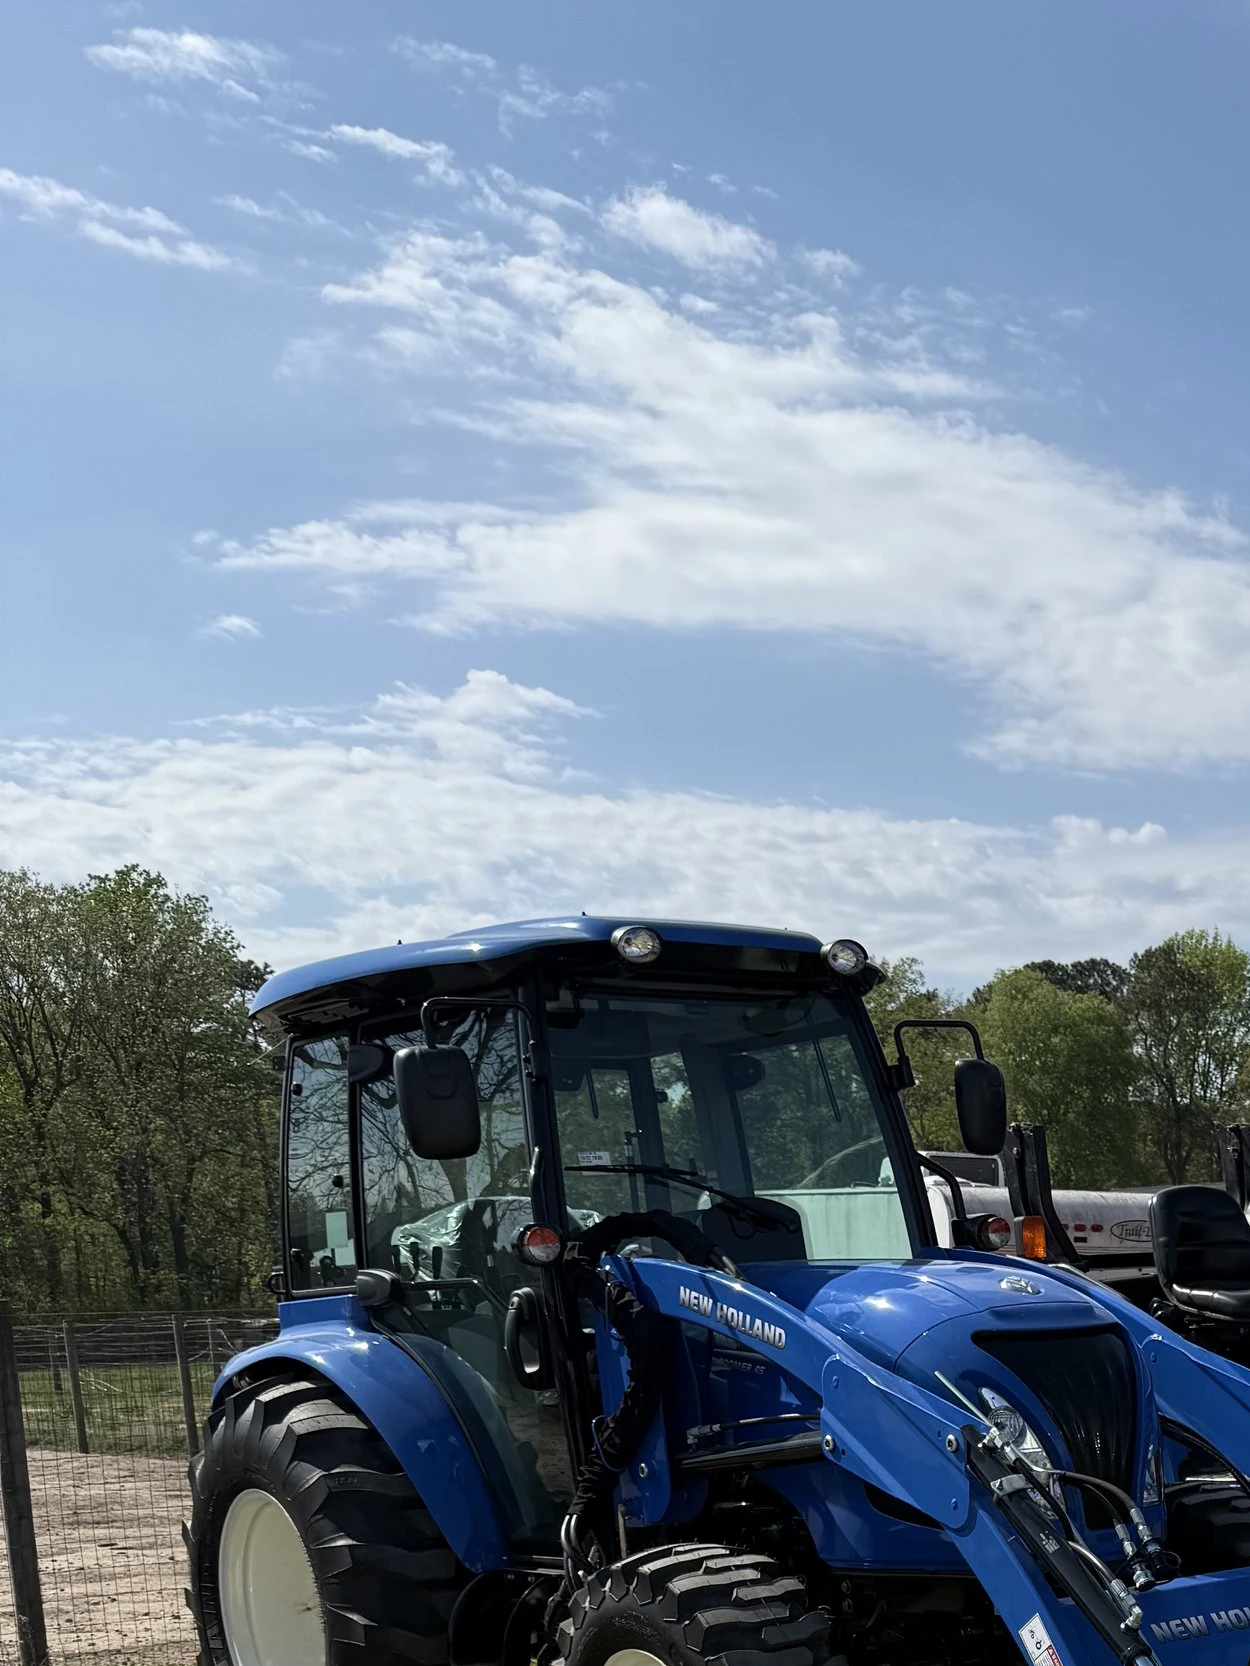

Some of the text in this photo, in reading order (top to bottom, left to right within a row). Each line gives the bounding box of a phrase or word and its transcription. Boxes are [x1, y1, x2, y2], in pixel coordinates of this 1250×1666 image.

[679, 1285, 786, 1349] NEW HOLLAND
[1151, 1614, 1209, 1643] NEW
